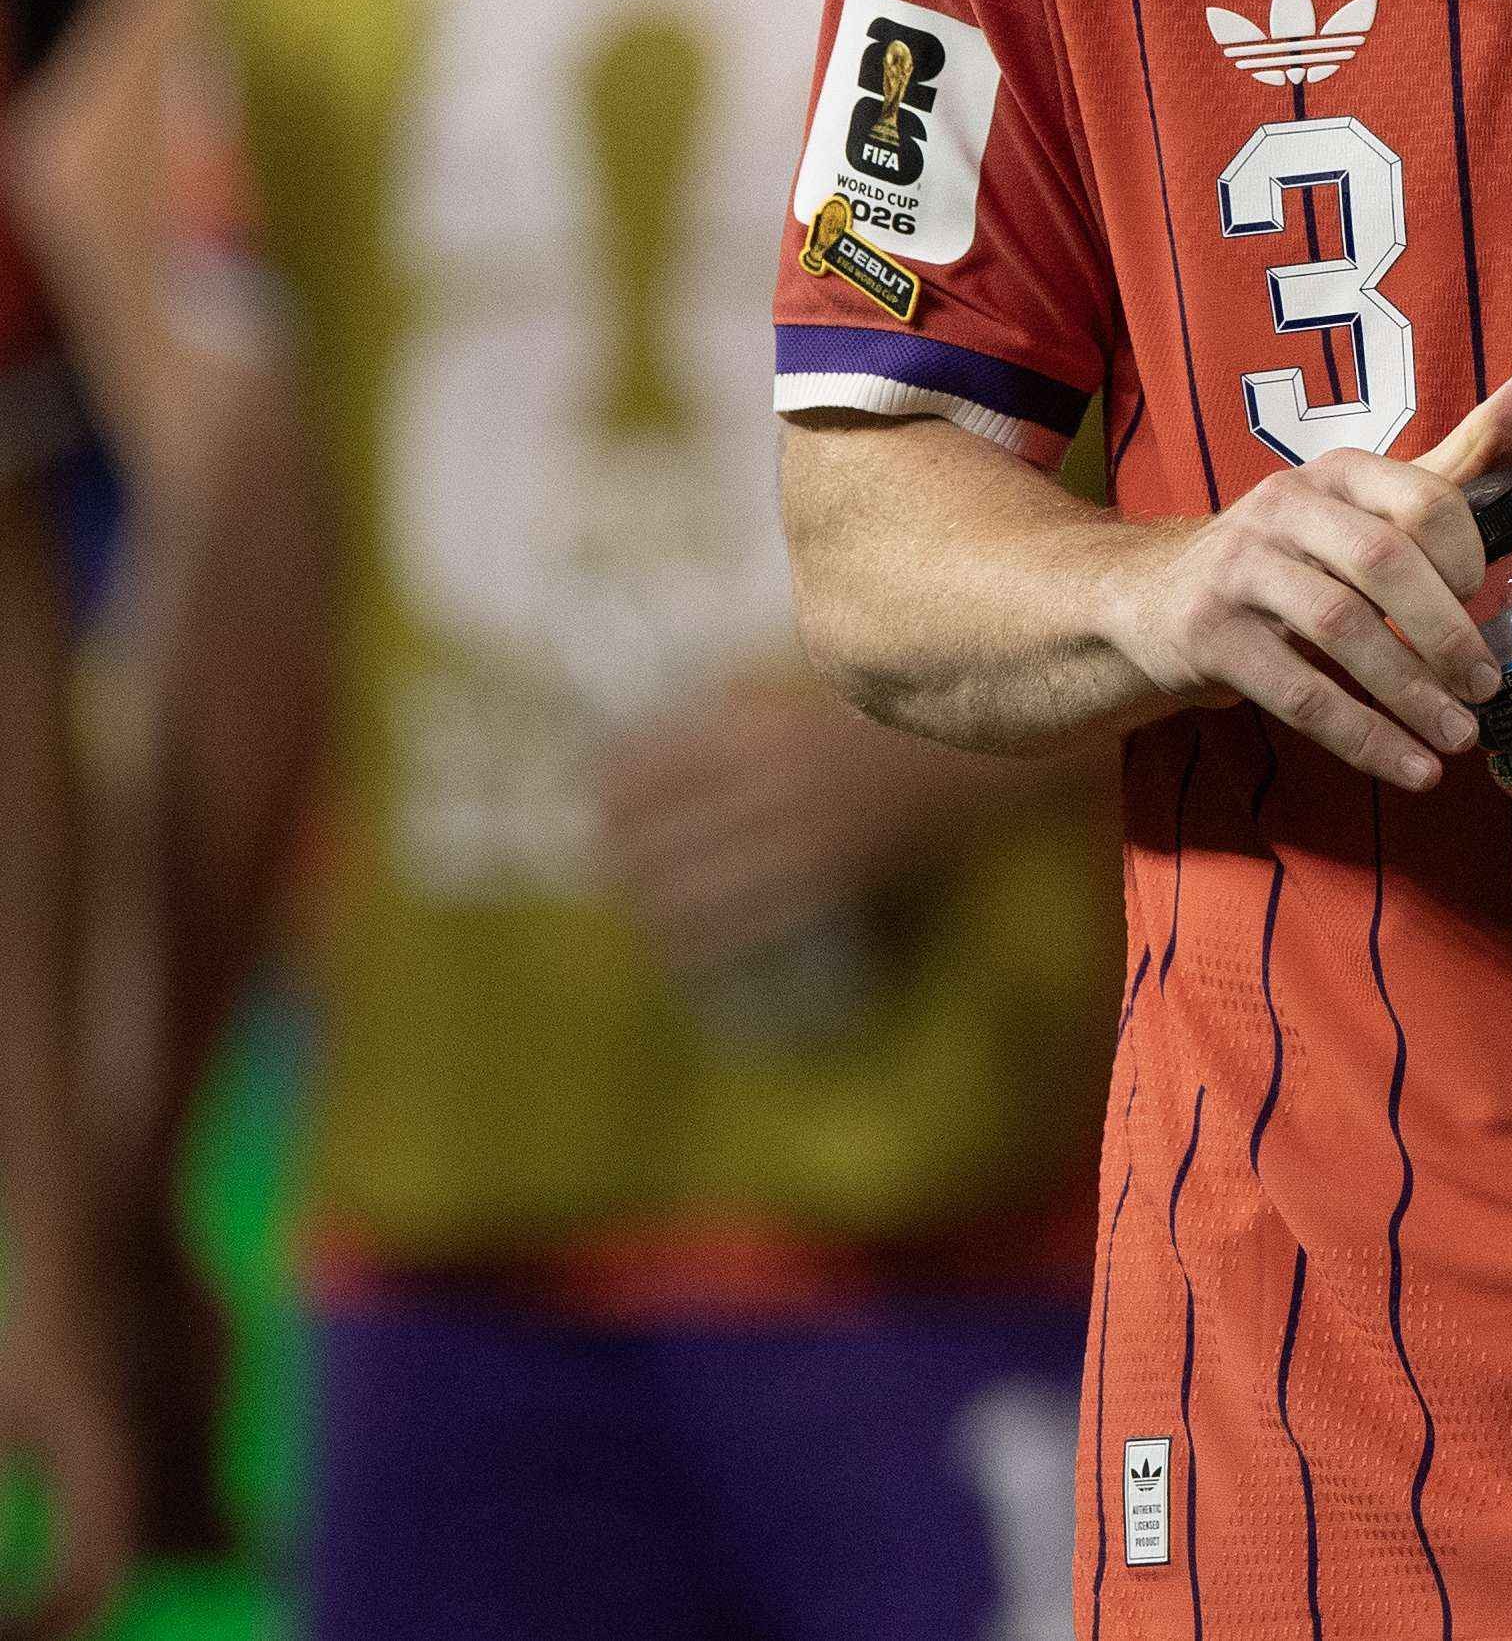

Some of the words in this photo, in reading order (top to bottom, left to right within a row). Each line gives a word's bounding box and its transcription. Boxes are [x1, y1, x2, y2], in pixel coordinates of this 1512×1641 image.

[862, 143, 899, 171] FIFA
[837, 173, 885, 200] WORLD
[887, 193, 919, 210] CUP
[834, 192, 916, 236] 026
[838, 238, 910, 295] DEBUT
[1216, 116, 1417, 467] 3
